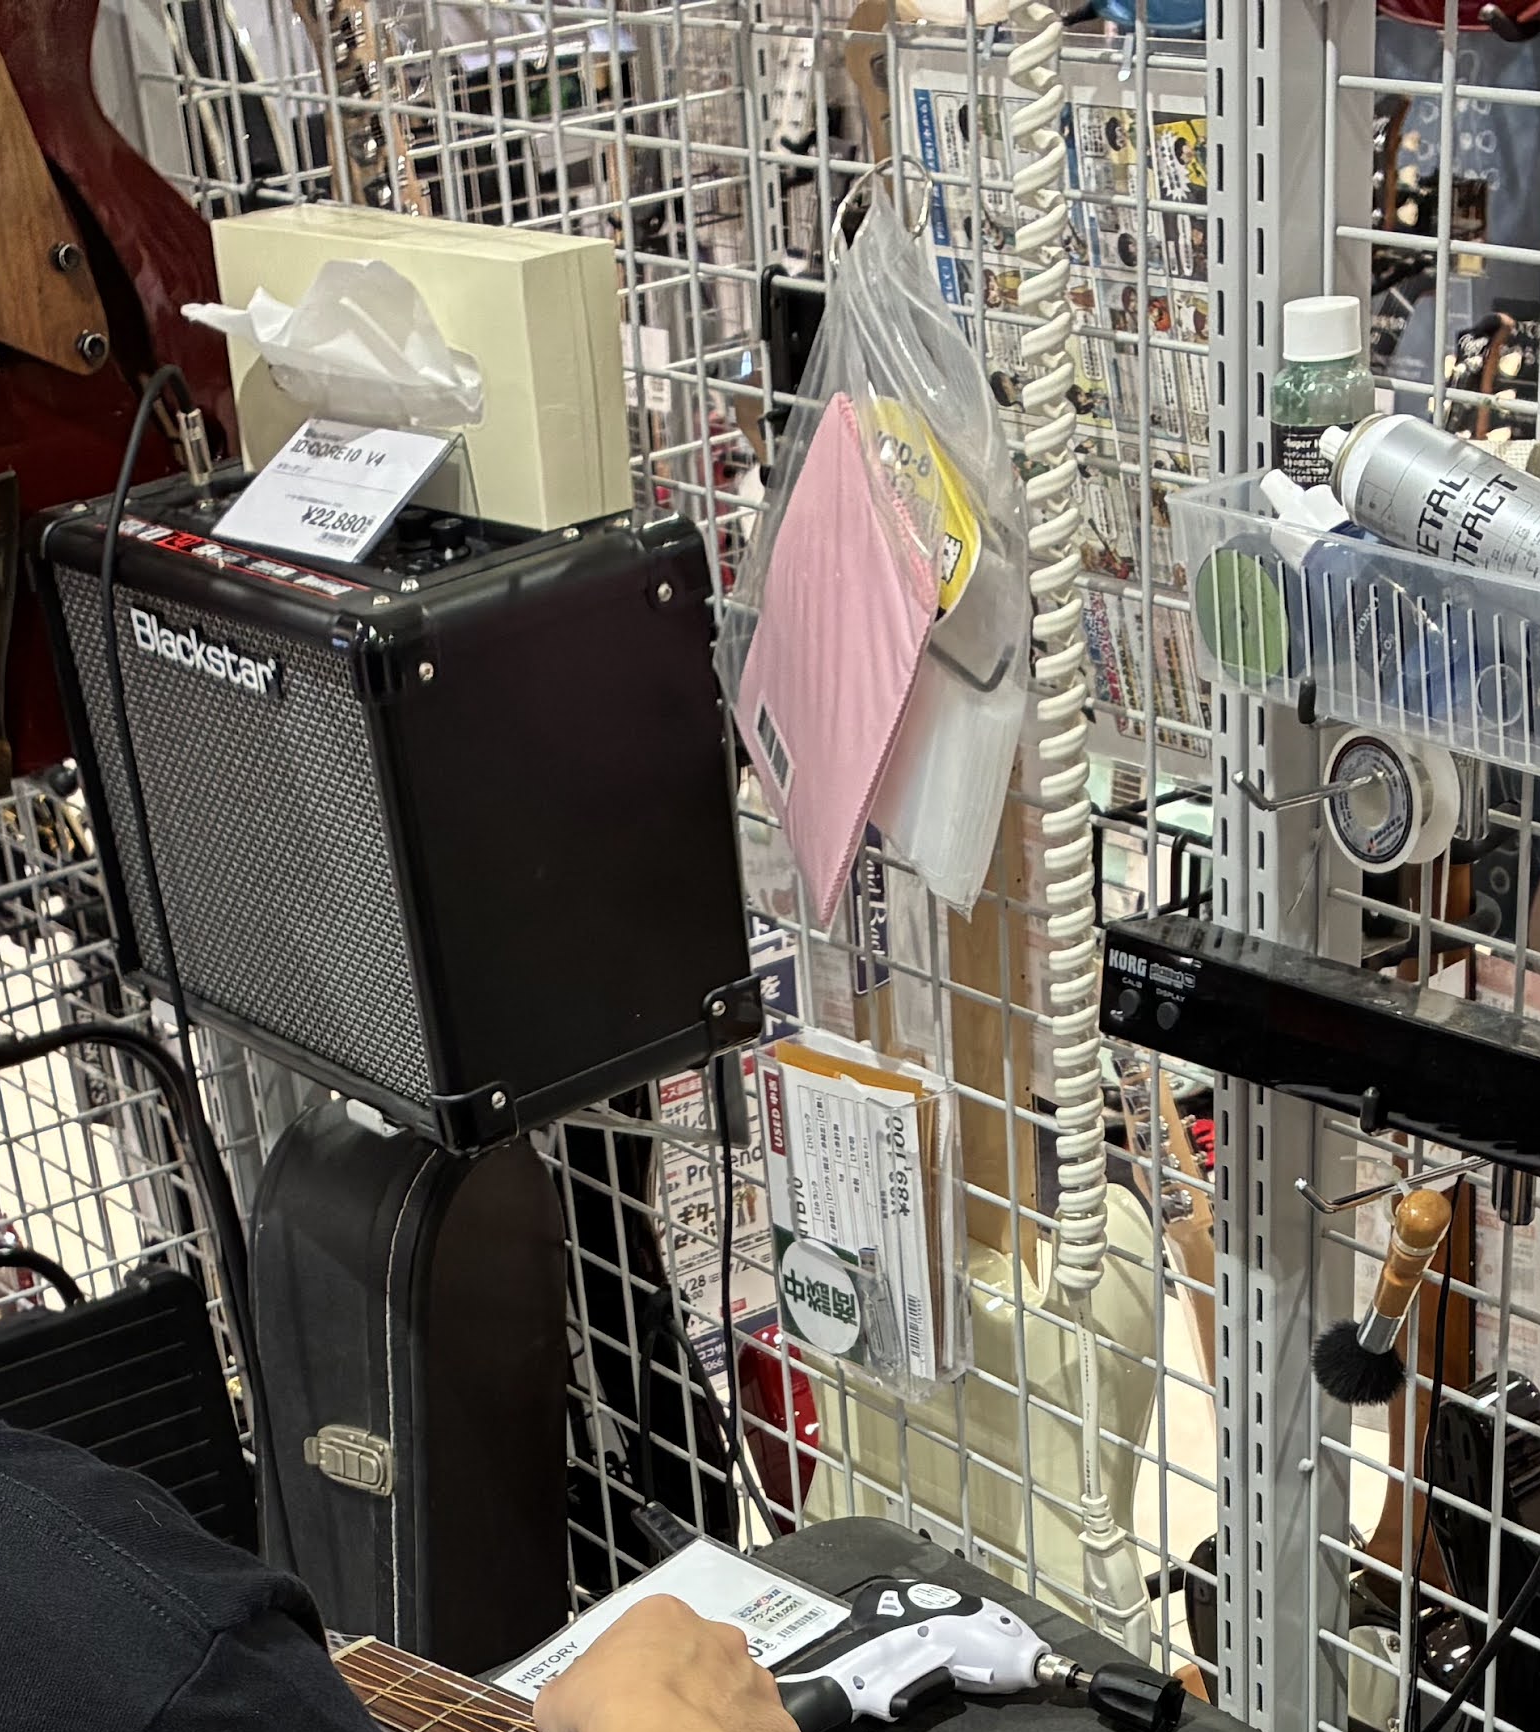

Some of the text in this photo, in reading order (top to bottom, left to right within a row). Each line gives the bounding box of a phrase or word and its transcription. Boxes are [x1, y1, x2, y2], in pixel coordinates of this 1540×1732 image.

[366, 450, 387, 468] V4
[301, 504, 366, 535] ¥22,880
[130, 607, 277, 695] Blackstar
[1108, 948, 1148, 977] KORG
[770, 1107, 784, 1149] USED
[782, 1268, 859, 1328] 商談中
[516, 1640, 580, 1685] HISTORY
